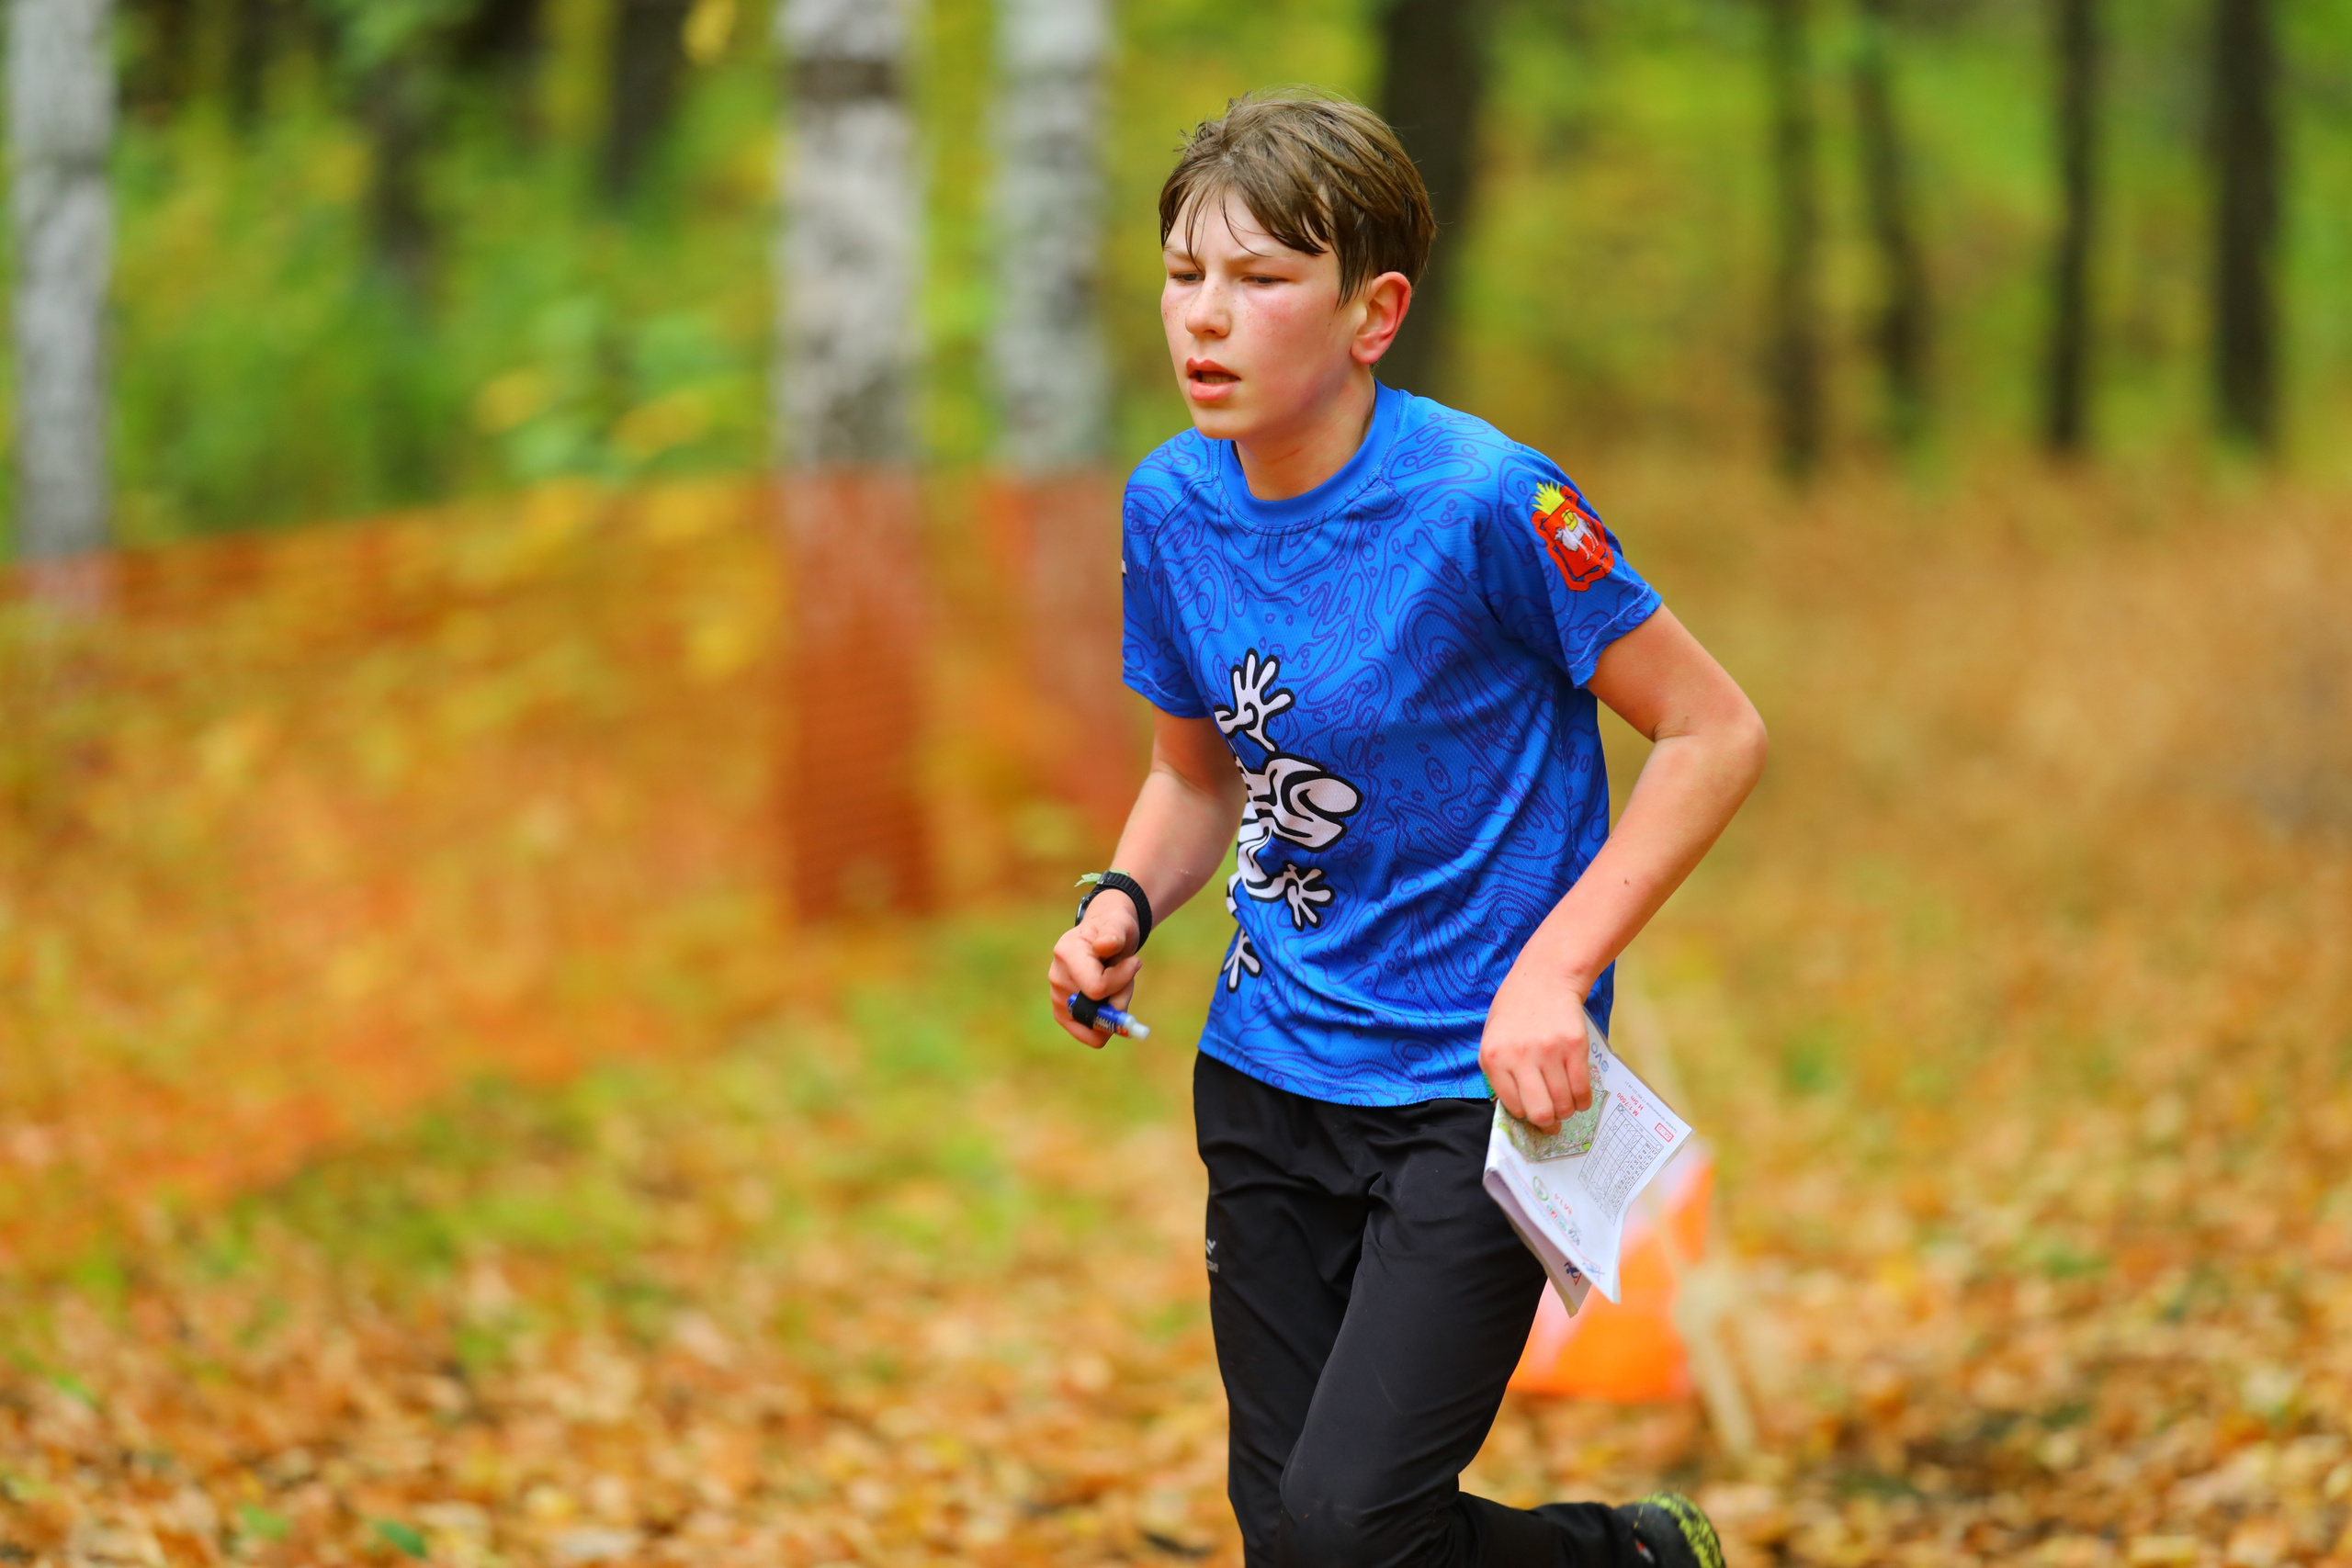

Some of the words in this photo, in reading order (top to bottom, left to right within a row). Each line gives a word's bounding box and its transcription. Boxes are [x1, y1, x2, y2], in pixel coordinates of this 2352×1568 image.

[1590, 1042, 1610, 1073] evo
[1616, 1091, 1634, 1111] 1:7500
[1629, 1095, 1638, 1104] 5m
